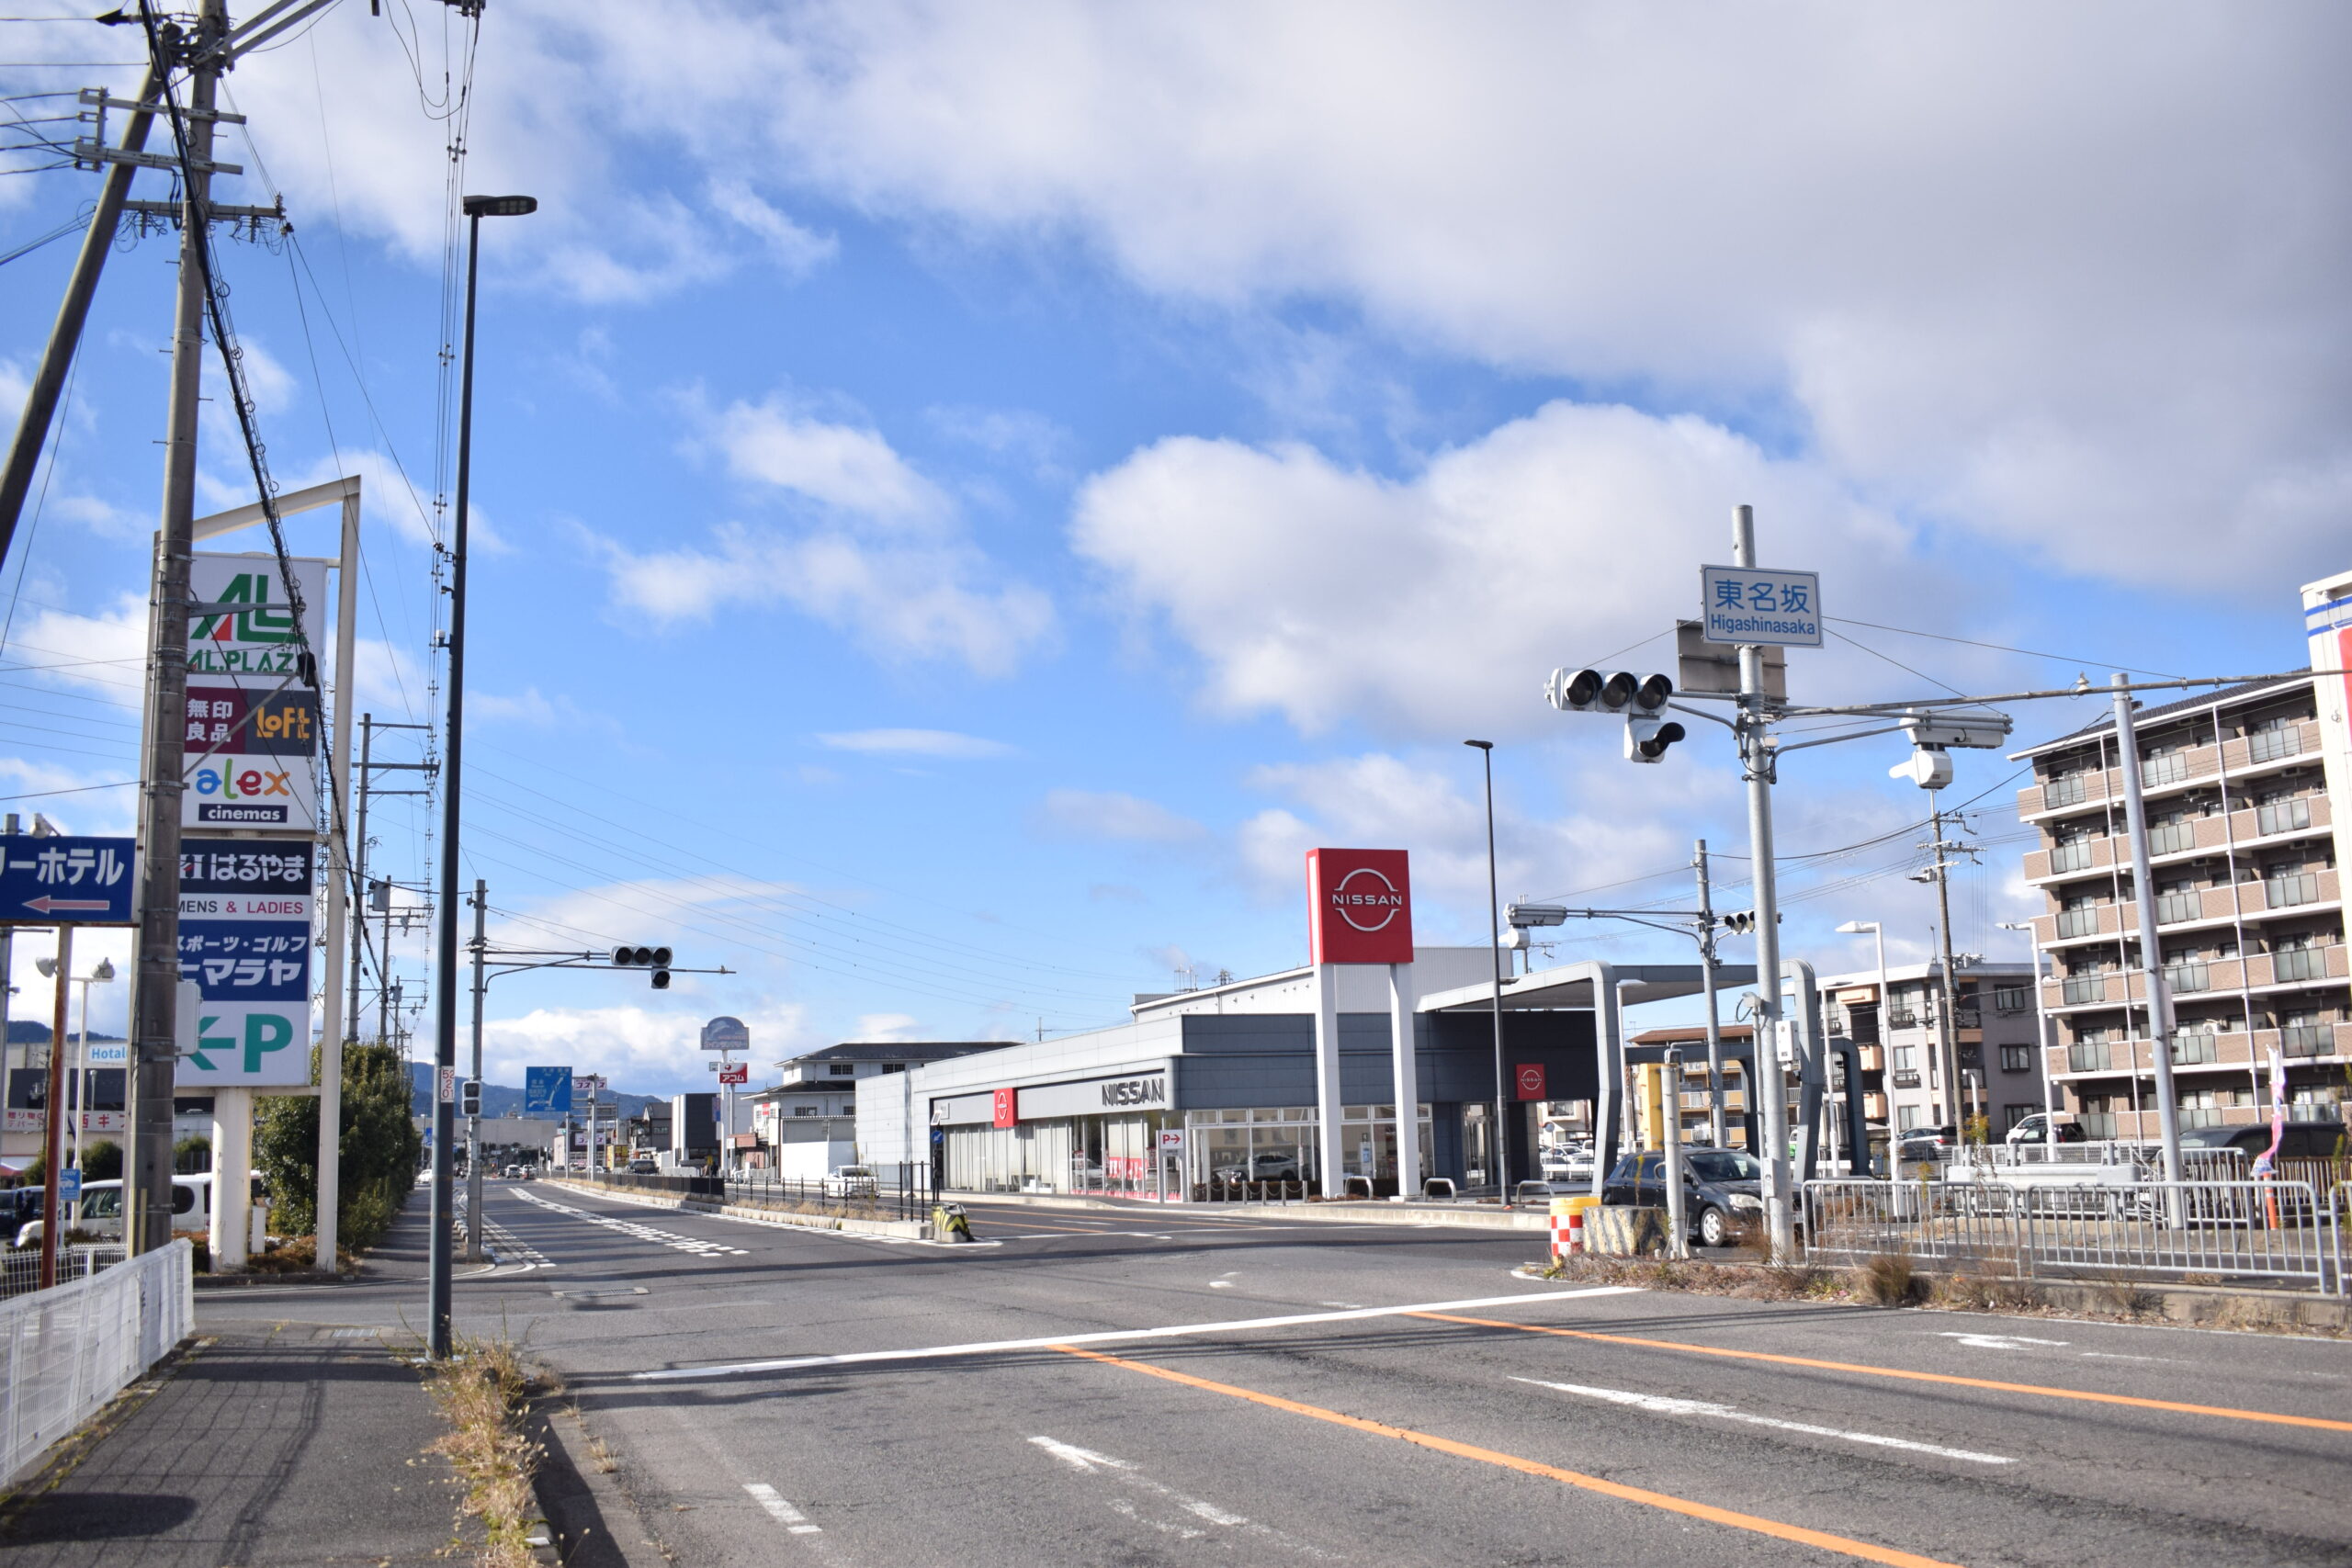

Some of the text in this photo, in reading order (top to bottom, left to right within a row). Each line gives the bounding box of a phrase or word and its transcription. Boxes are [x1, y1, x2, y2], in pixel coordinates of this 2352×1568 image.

[1714, 579, 1810, 614] 東名坂
[1711, 614, 1816, 636] Higashinasaka
[187, 649, 300, 672] AL.PLAZ
[187, 699, 233, 719] 無印
[186, 722, 232, 742] 良品
[196, 758, 290, 800] alex
[208, 806, 280, 821] cinemas
[210, 853, 306, 882] はるやま
[226, 901, 237, 913] &
[247, 902, 303, 914] LADIES
[1332, 894, 1402, 905] NISSAN
[92, 1045, 128, 1060] Hotal
[243, 1013, 293, 1074] P
[442, 1069, 455, 1079] 52
[446, 1078, 452, 1089] 2
[442, 1089, 454, 1099] 01
[1102, 1077, 1165, 1107] NISSAN
[1161, 1134, 1171, 1145] P
